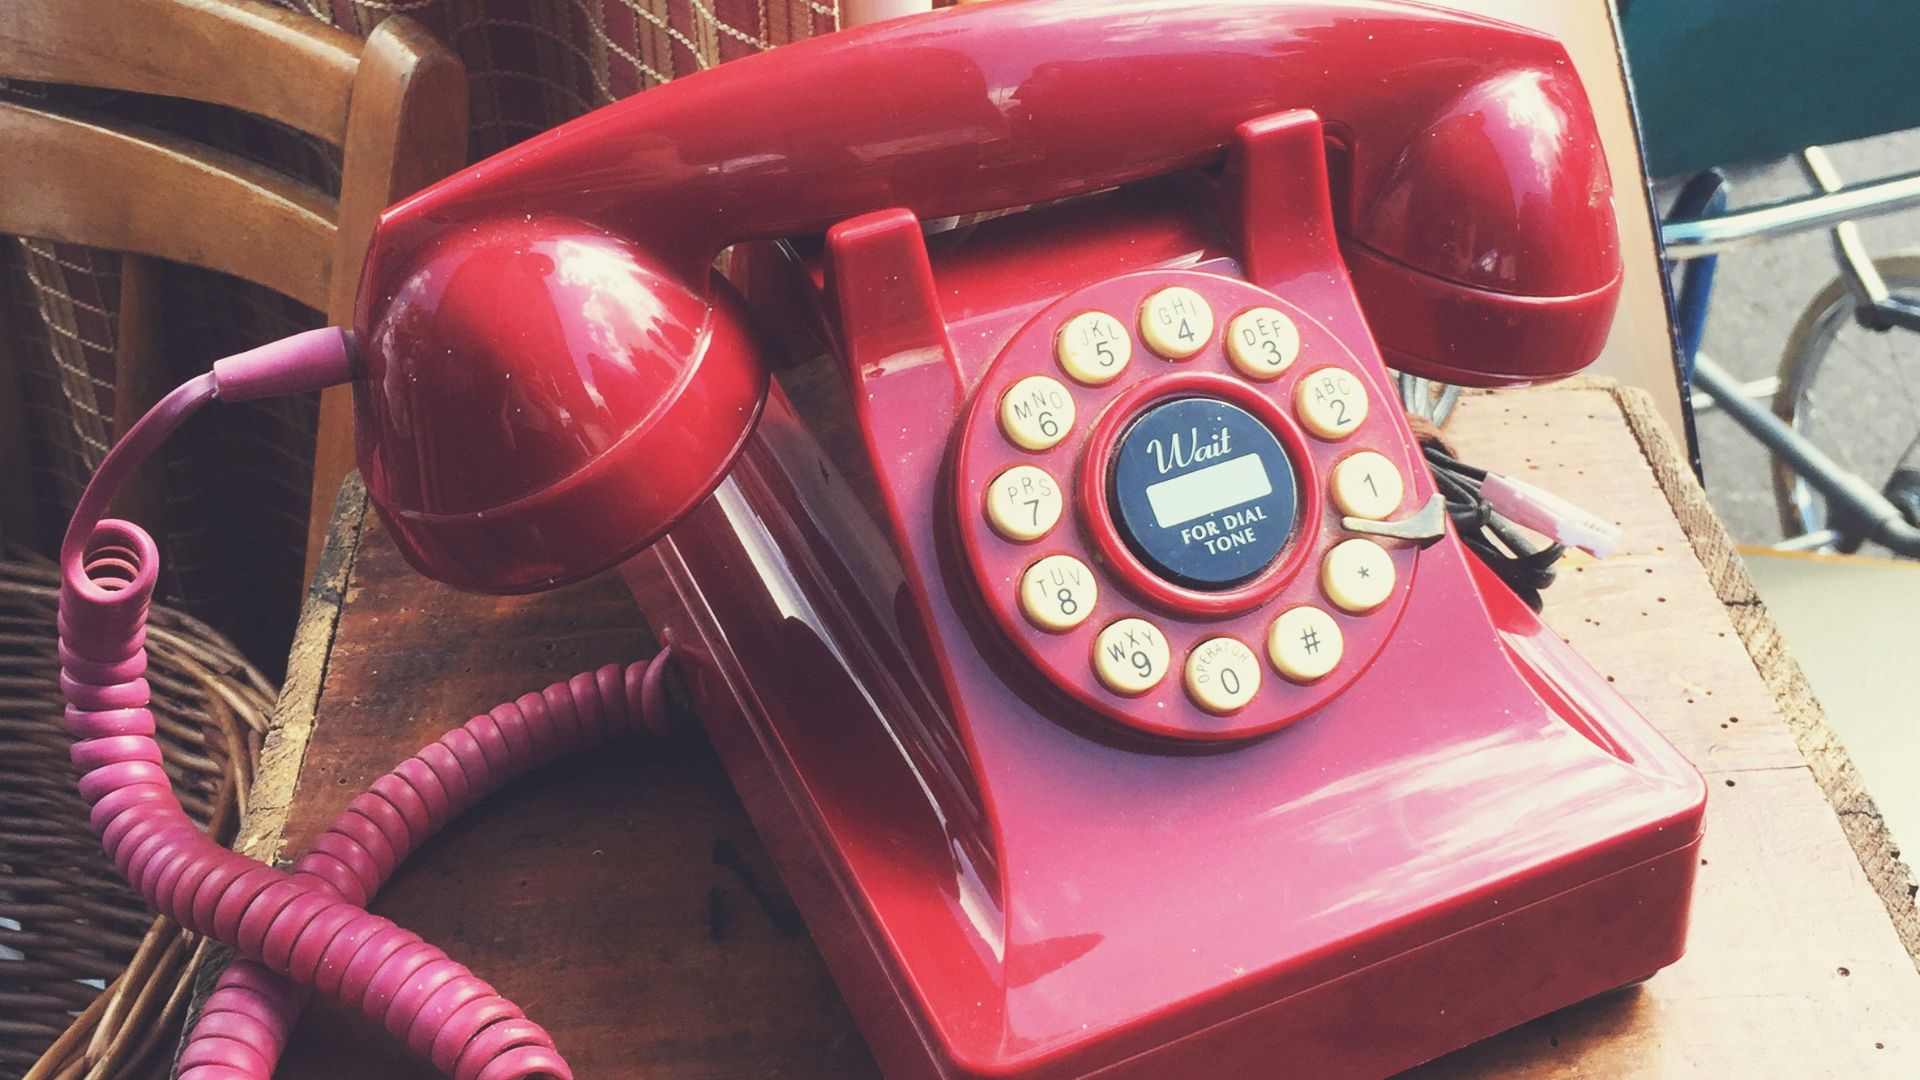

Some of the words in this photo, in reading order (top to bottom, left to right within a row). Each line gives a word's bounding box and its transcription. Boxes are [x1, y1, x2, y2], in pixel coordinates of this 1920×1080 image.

[1159, 297, 1198, 325] GHI
[1081, 320, 1120, 346] JKL
[1178, 318, 1195, 342] 4
[1242, 318, 1282, 346] DEF
[1096, 341, 1115, 366] 5
[1262, 340, 1282, 365] 3
[1315, 377, 1350, 404] ABC
[1014, 390, 1063, 421] MNO
[1330, 399, 1352, 426] 2
[1039, 411, 1059, 437] 6
[1146, 427, 1232, 474] Wait
[1007, 476, 1052, 504] PRS
[1363, 473, 1378, 498] 1
[1023, 499, 1039, 526] 7
[1181, 521, 1220, 544] FOR
[1223, 506, 1267, 530] DIAL
[1204, 528, 1257, 555] TONE
[1036, 567, 1081, 598] TUV
[1057, 588, 1078, 615] 8
[1107, 628, 1154, 663] WXY
[1300, 626, 1321, 656] #
[1131, 651, 1152, 678] 9
[1221, 667, 1240, 695] 0
